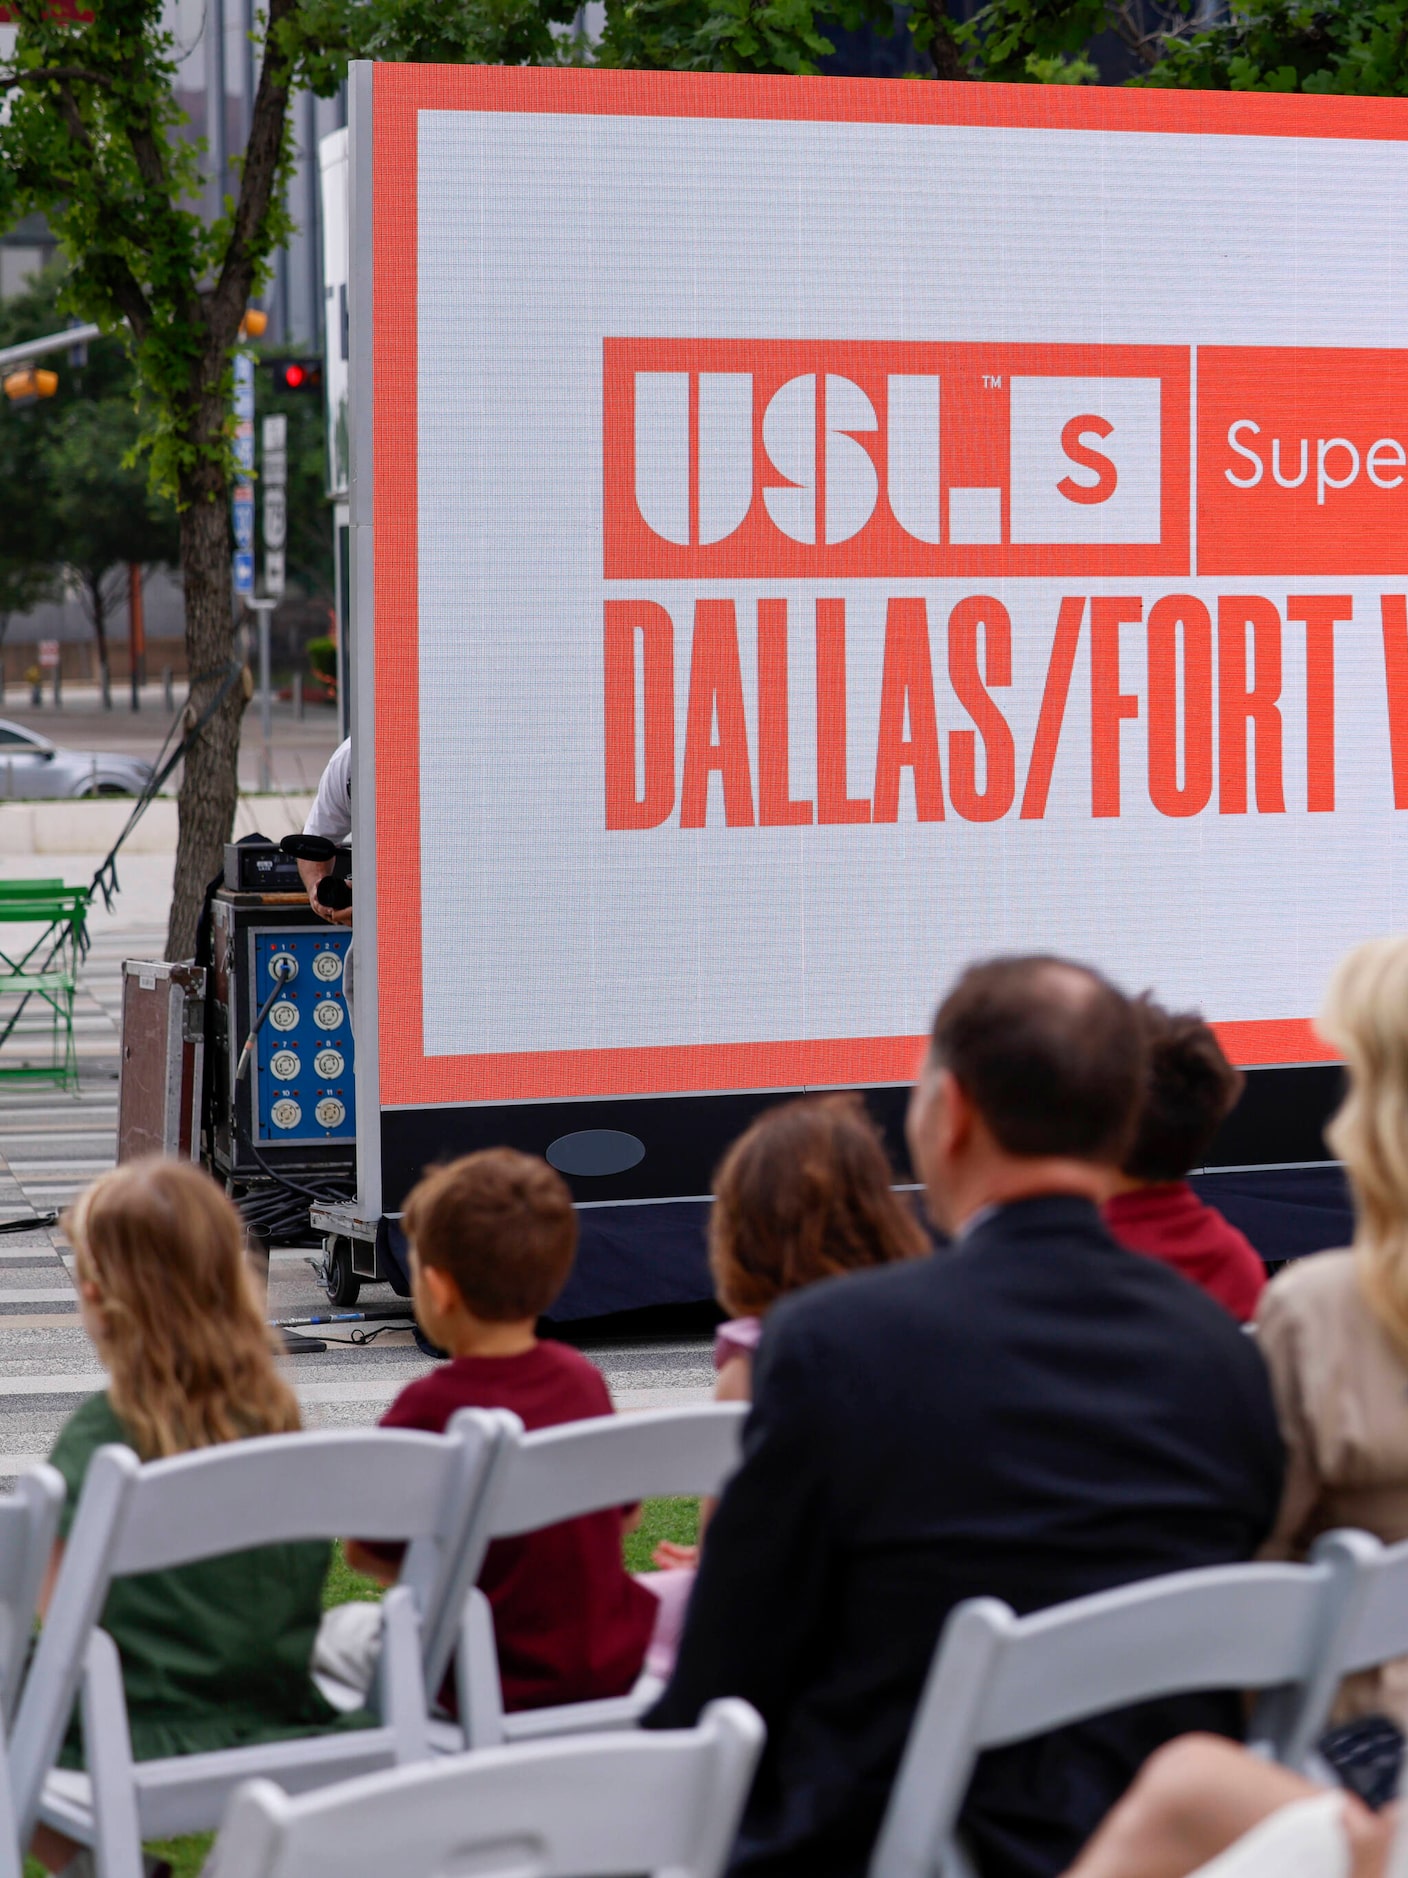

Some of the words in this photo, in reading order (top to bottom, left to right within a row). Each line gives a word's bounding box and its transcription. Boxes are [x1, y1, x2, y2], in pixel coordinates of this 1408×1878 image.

[634, 371, 1002, 546] USL
[603, 592, 1353, 831] DALLAS/FORT
[282, 1089, 291, 1097] 10
